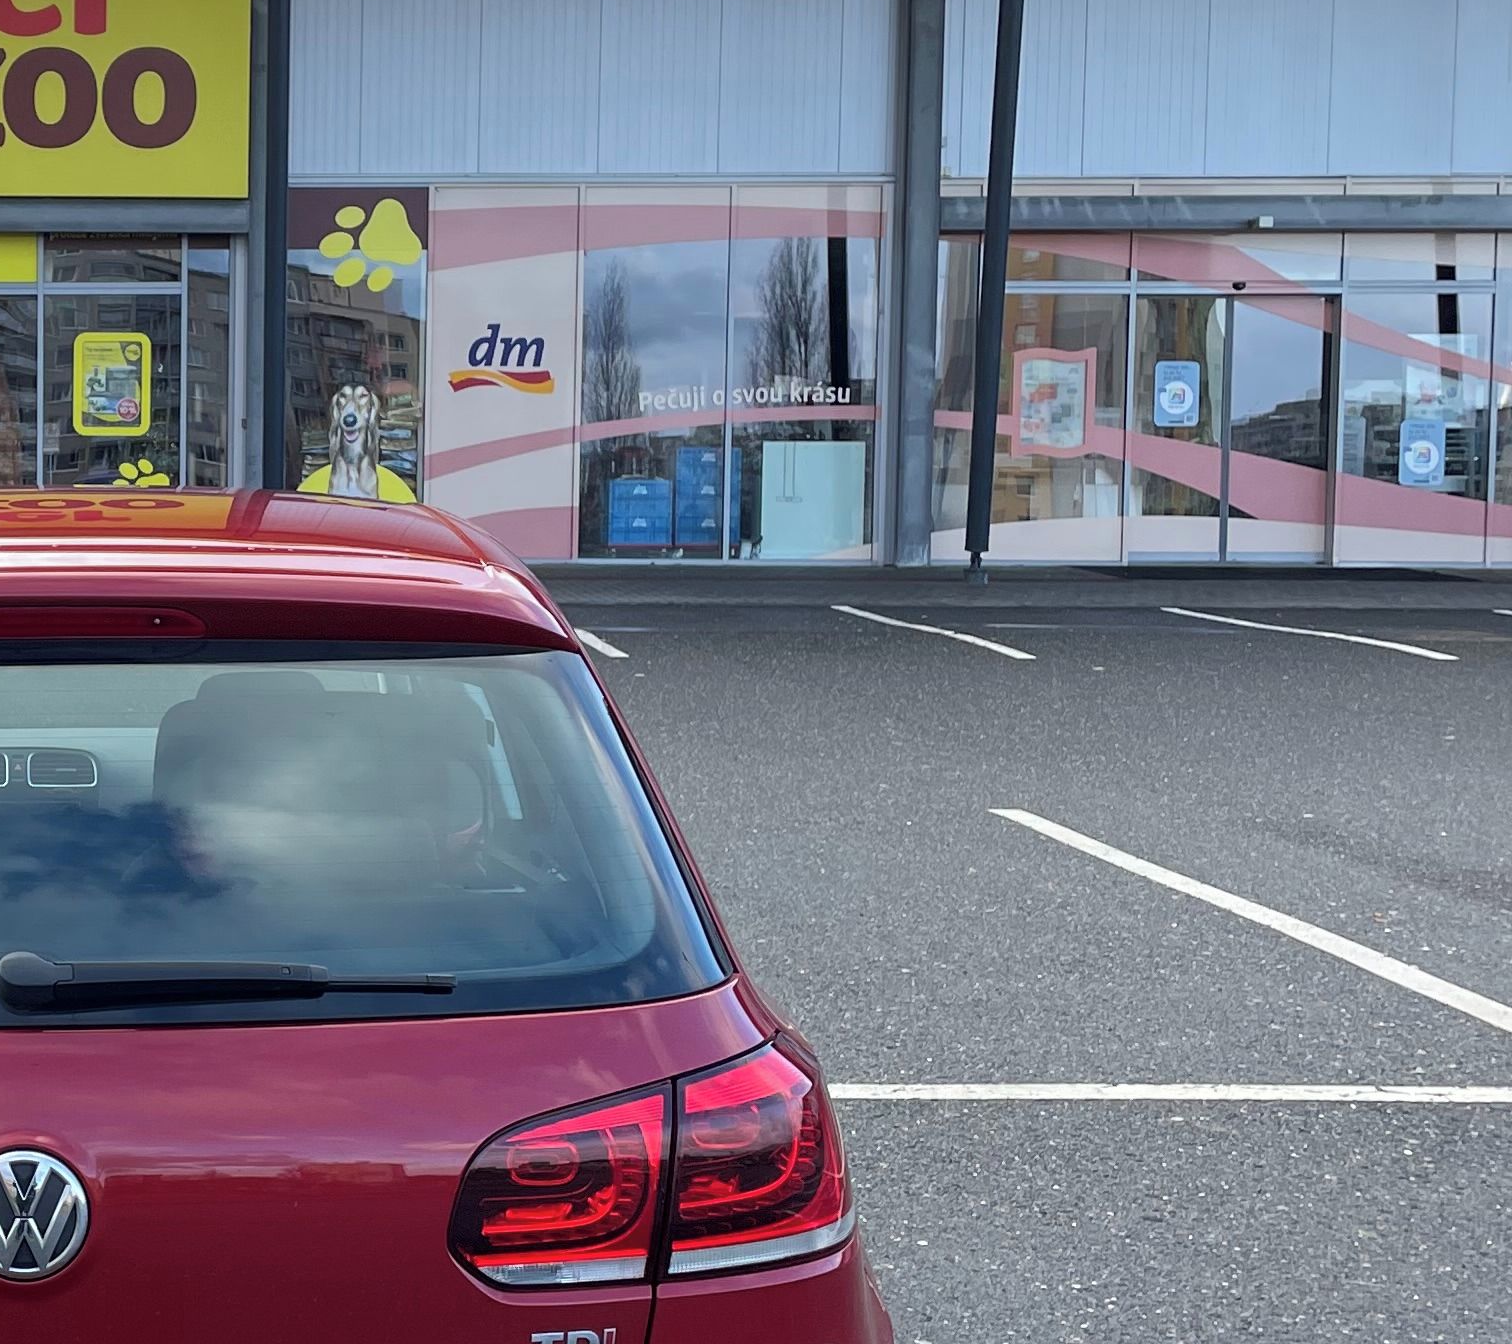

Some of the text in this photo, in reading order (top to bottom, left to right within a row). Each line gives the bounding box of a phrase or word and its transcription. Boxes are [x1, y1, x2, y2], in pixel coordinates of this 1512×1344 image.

[468, 324, 545, 367] dm
[639, 378, 851, 412] Pečuji o svou krásu
